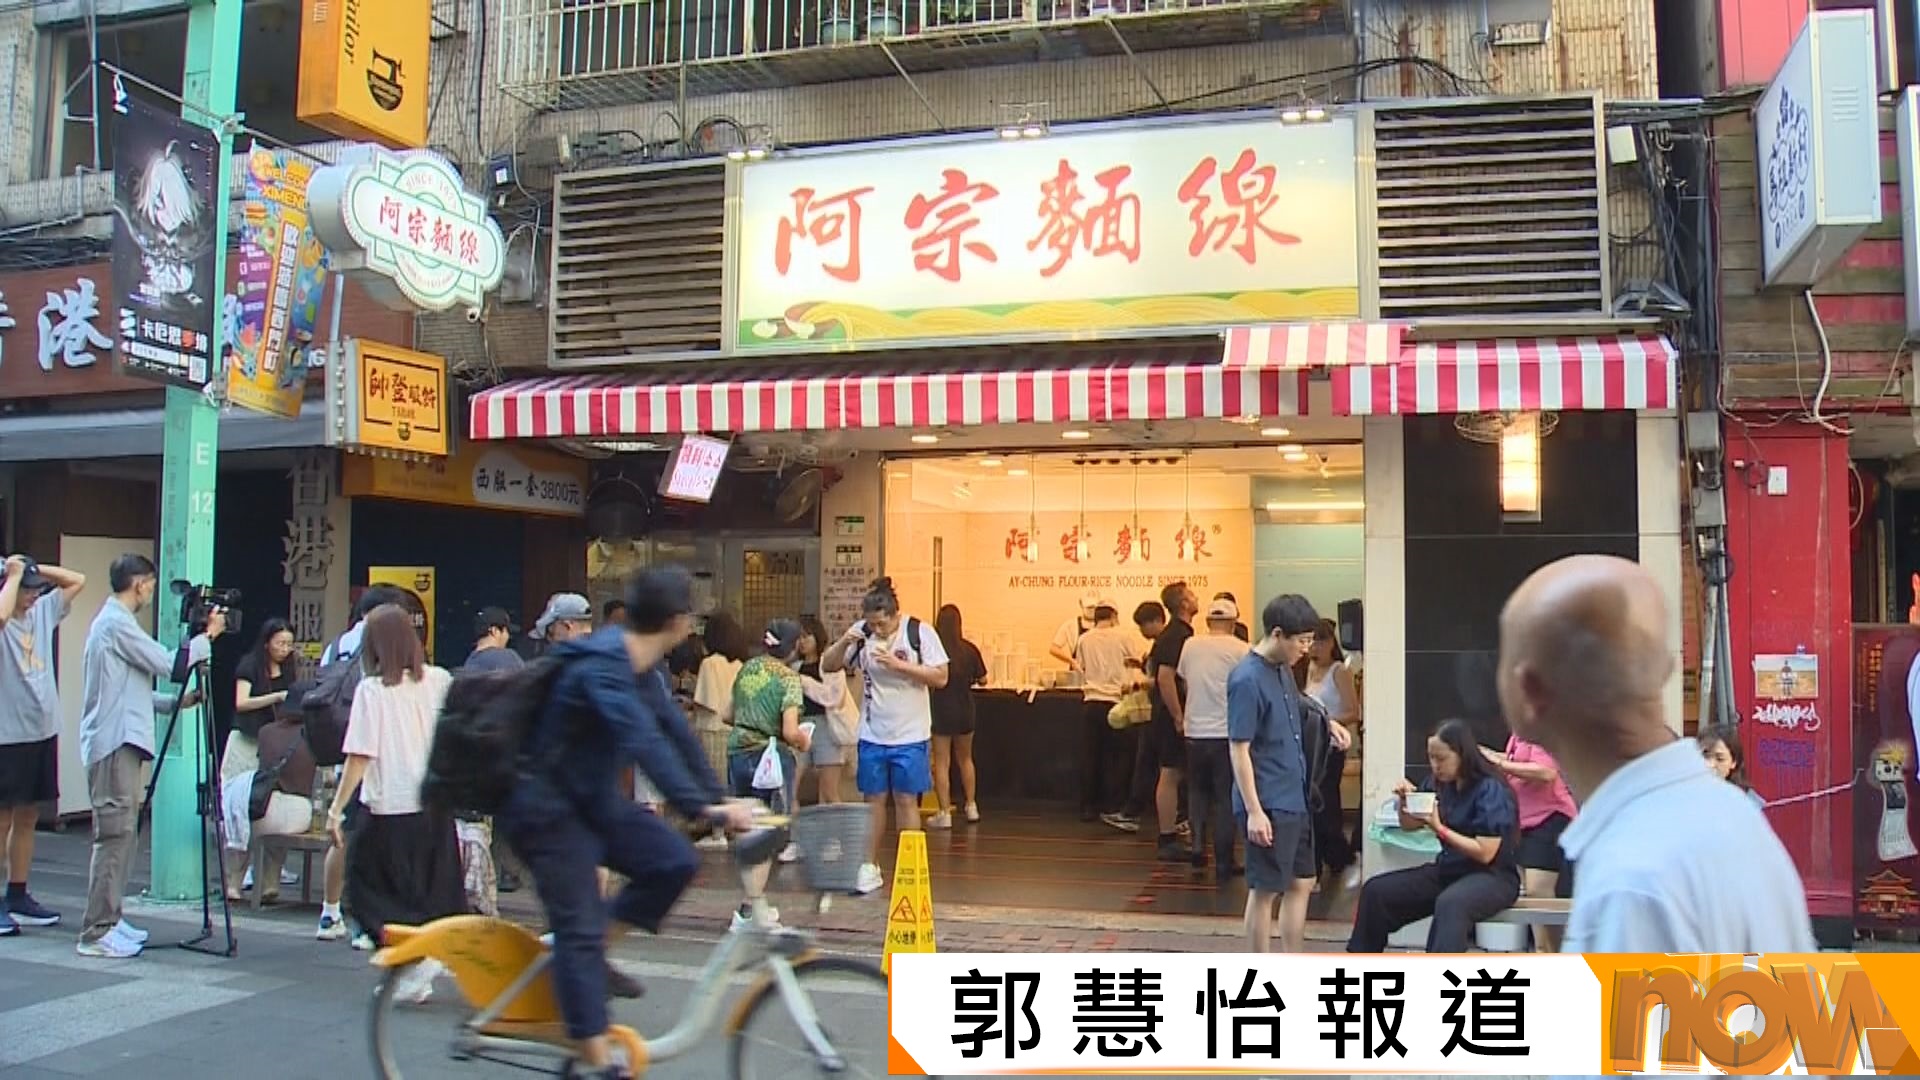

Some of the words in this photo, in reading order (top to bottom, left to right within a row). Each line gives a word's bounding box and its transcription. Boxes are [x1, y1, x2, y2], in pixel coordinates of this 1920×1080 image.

[343, 0, 361, 64] ailor
[261, 185, 309, 210] XIMEN
[380, 196, 479, 265] 阿宗麵線
[773, 148, 1302, 283] 阿宗麵線
[196, 442, 209, 465] E
[476, 468, 580, 505] 西服一套3800元
[192, 492, 215, 513] 12
[1008, 576, 1054, 588] AY-CHUNG
[1116, 576, 1153, 588] NOODLE
[1188, 575, 1208, 588] 1975
